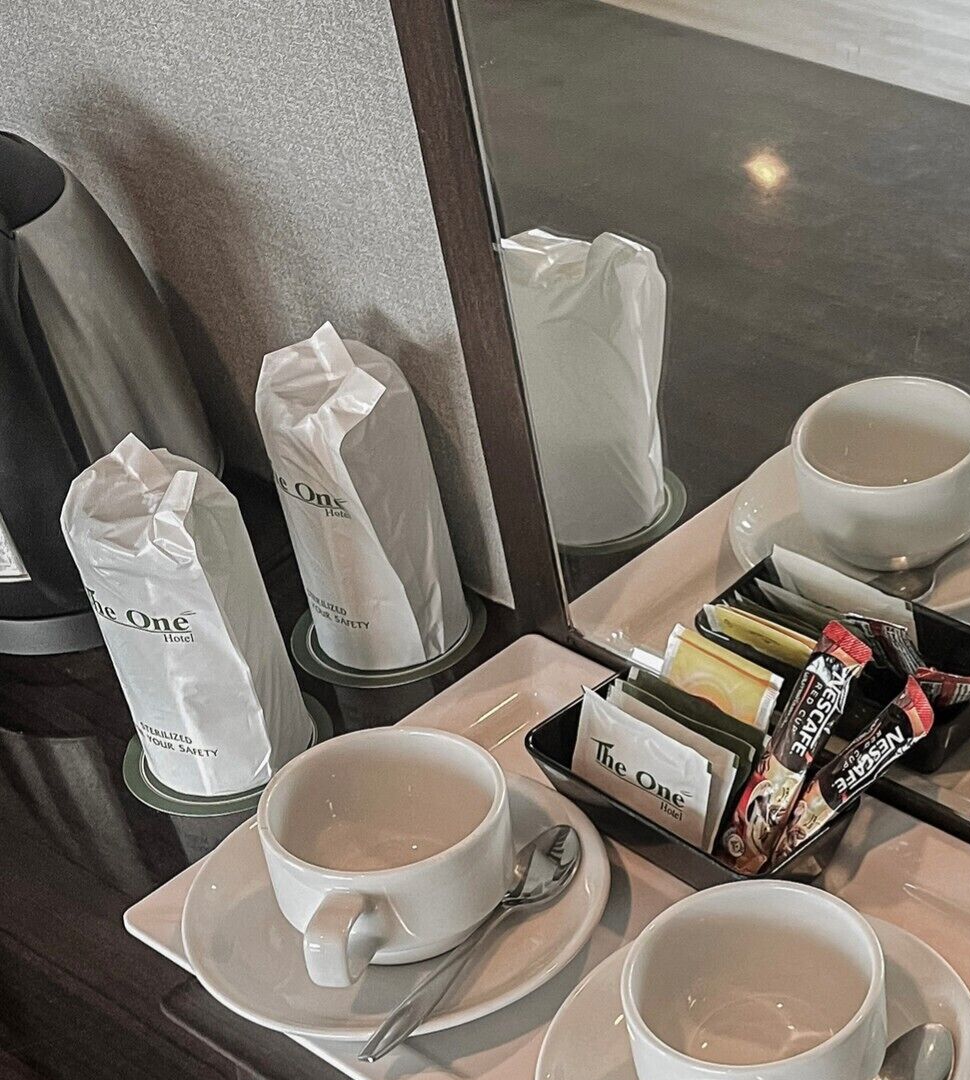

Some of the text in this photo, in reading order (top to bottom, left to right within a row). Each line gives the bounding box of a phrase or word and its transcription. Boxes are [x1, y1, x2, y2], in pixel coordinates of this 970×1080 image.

[126, 609, 190, 631] One
[163, 633, 195, 643] Hotel
[806, 682, 824, 706] RED
[791, 709, 807, 736] CUP
[147, 734, 219, 758] YOUR SAFETY
[590, 736, 685, 809] The One
[660, 802, 684, 822] Hotel
